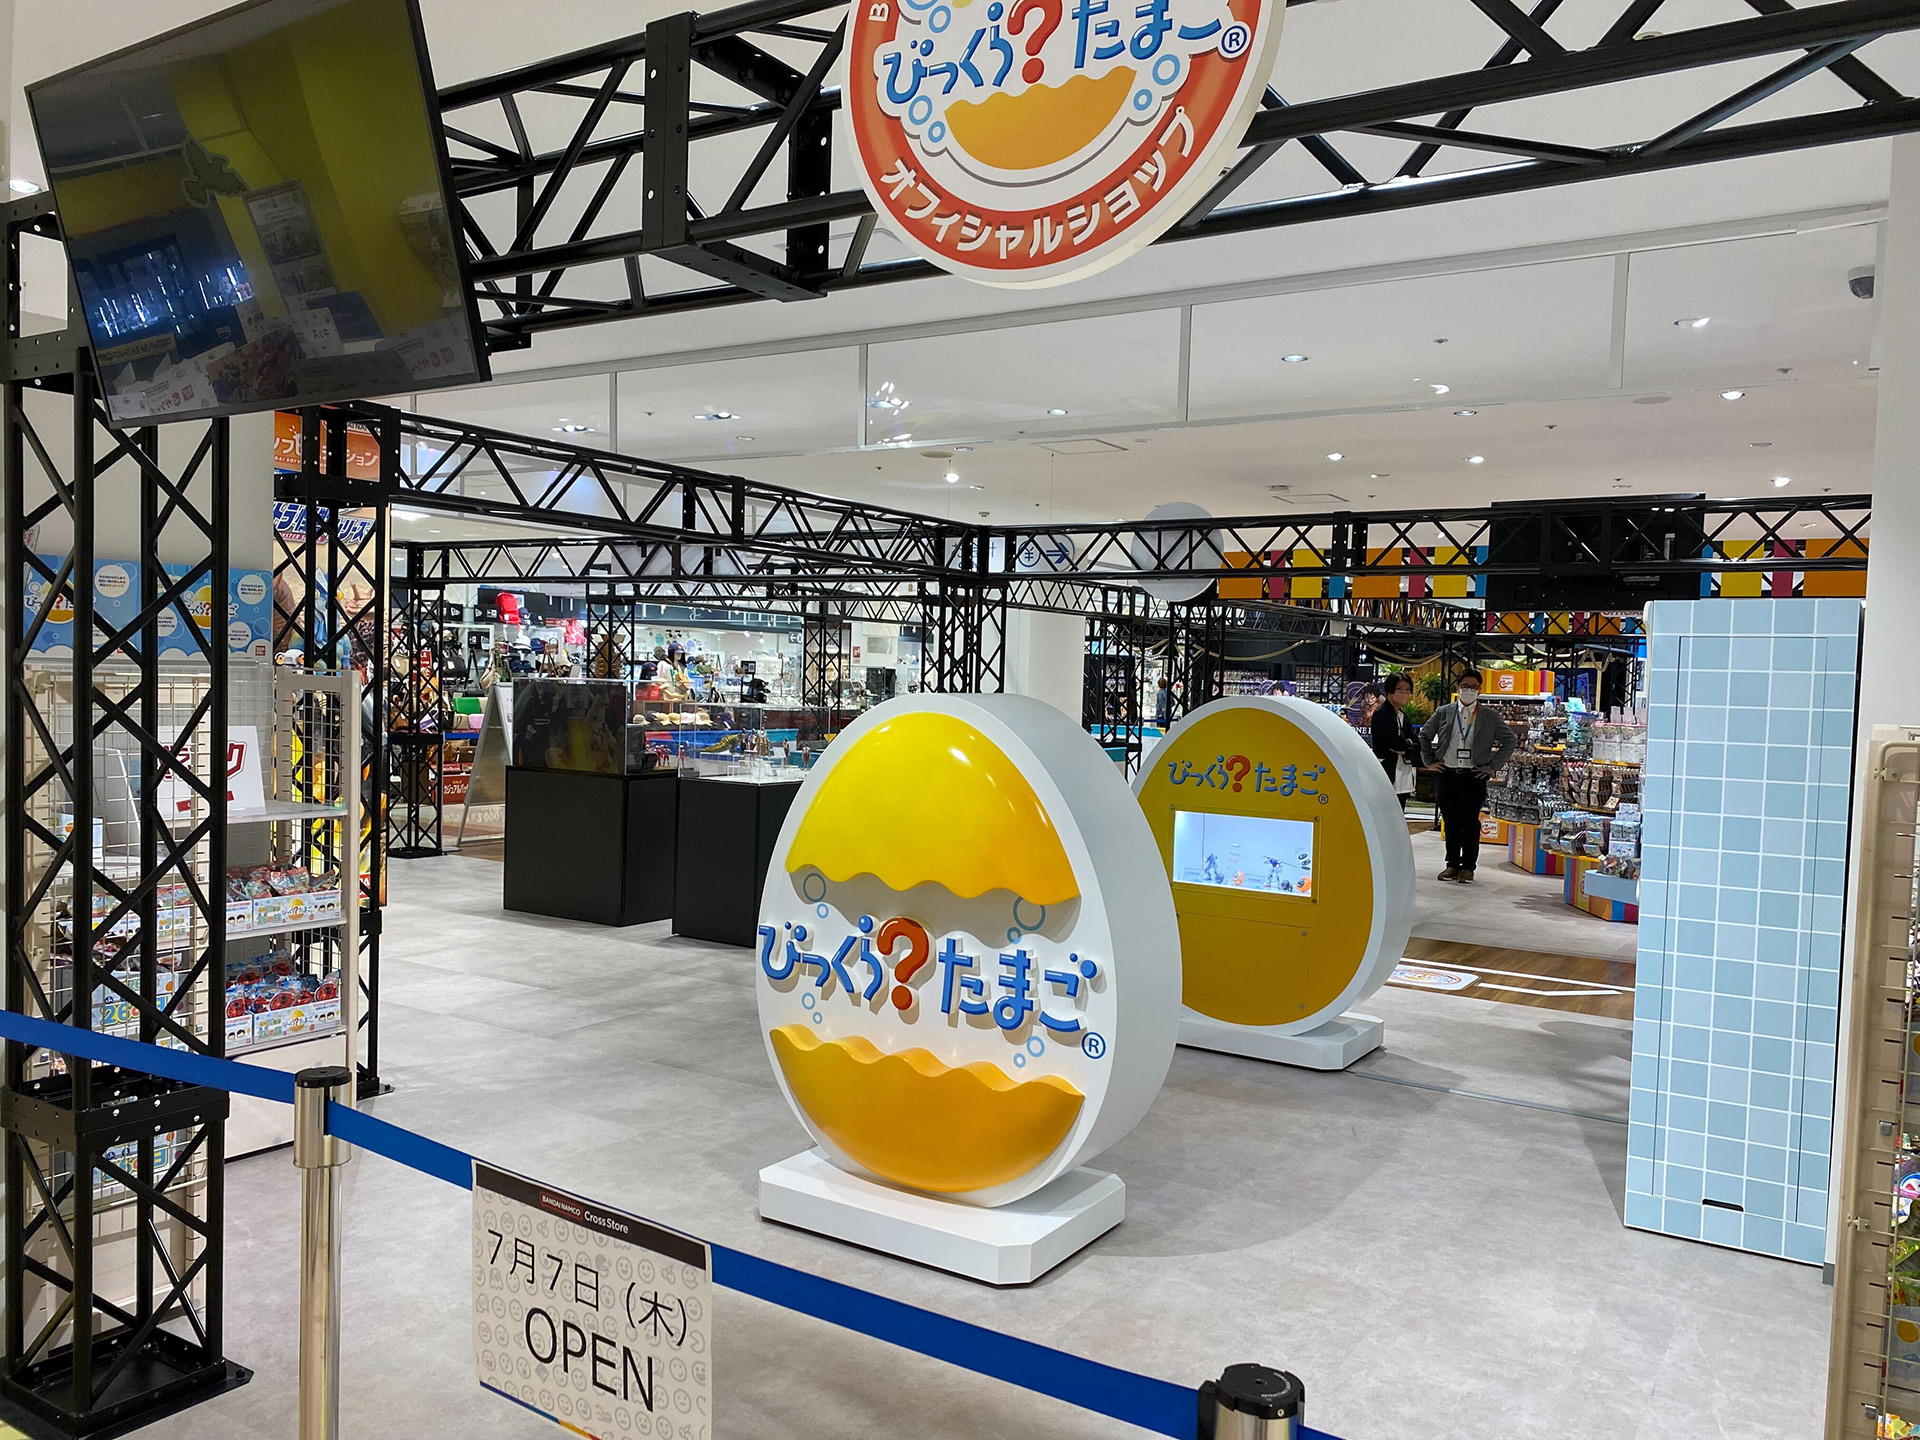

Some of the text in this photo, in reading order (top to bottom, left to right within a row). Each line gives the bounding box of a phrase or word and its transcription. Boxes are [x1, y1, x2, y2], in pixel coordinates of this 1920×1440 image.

[879, 104, 1196, 260] オフィシャルショップ
[1167, 754, 1326, 797] びっくら?たまご
[758, 914, 1098, 1033] びっくら?たまご
[584, 1210, 606, 1226] Cross
[606, 1217, 629, 1234] Store
[524, 1306, 654, 1413] OPEN
